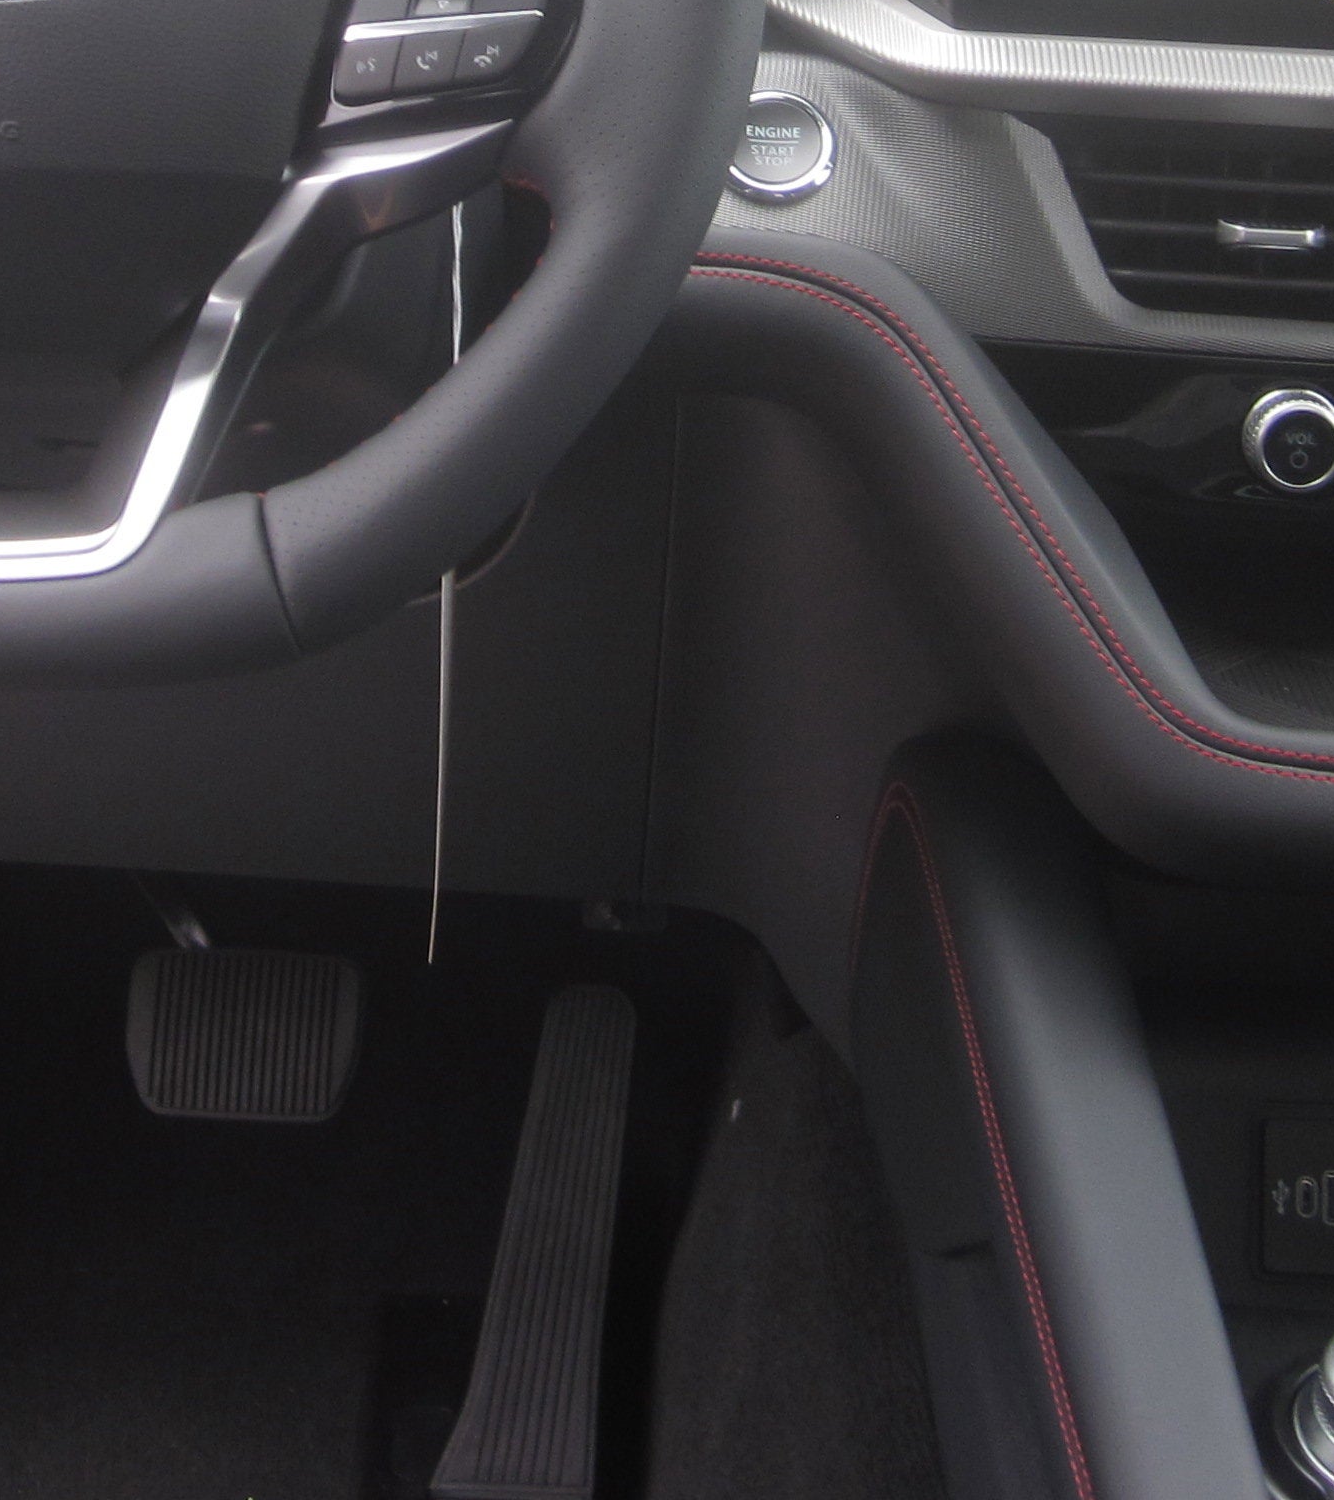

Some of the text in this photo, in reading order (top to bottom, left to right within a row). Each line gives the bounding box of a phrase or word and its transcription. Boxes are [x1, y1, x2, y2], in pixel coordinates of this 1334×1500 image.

[745, 125, 801, 139] ENGINE
[751, 145, 795, 156] START
[755, 155, 792, 166] STOP
[1285, 432, 1316, 445] VOL
